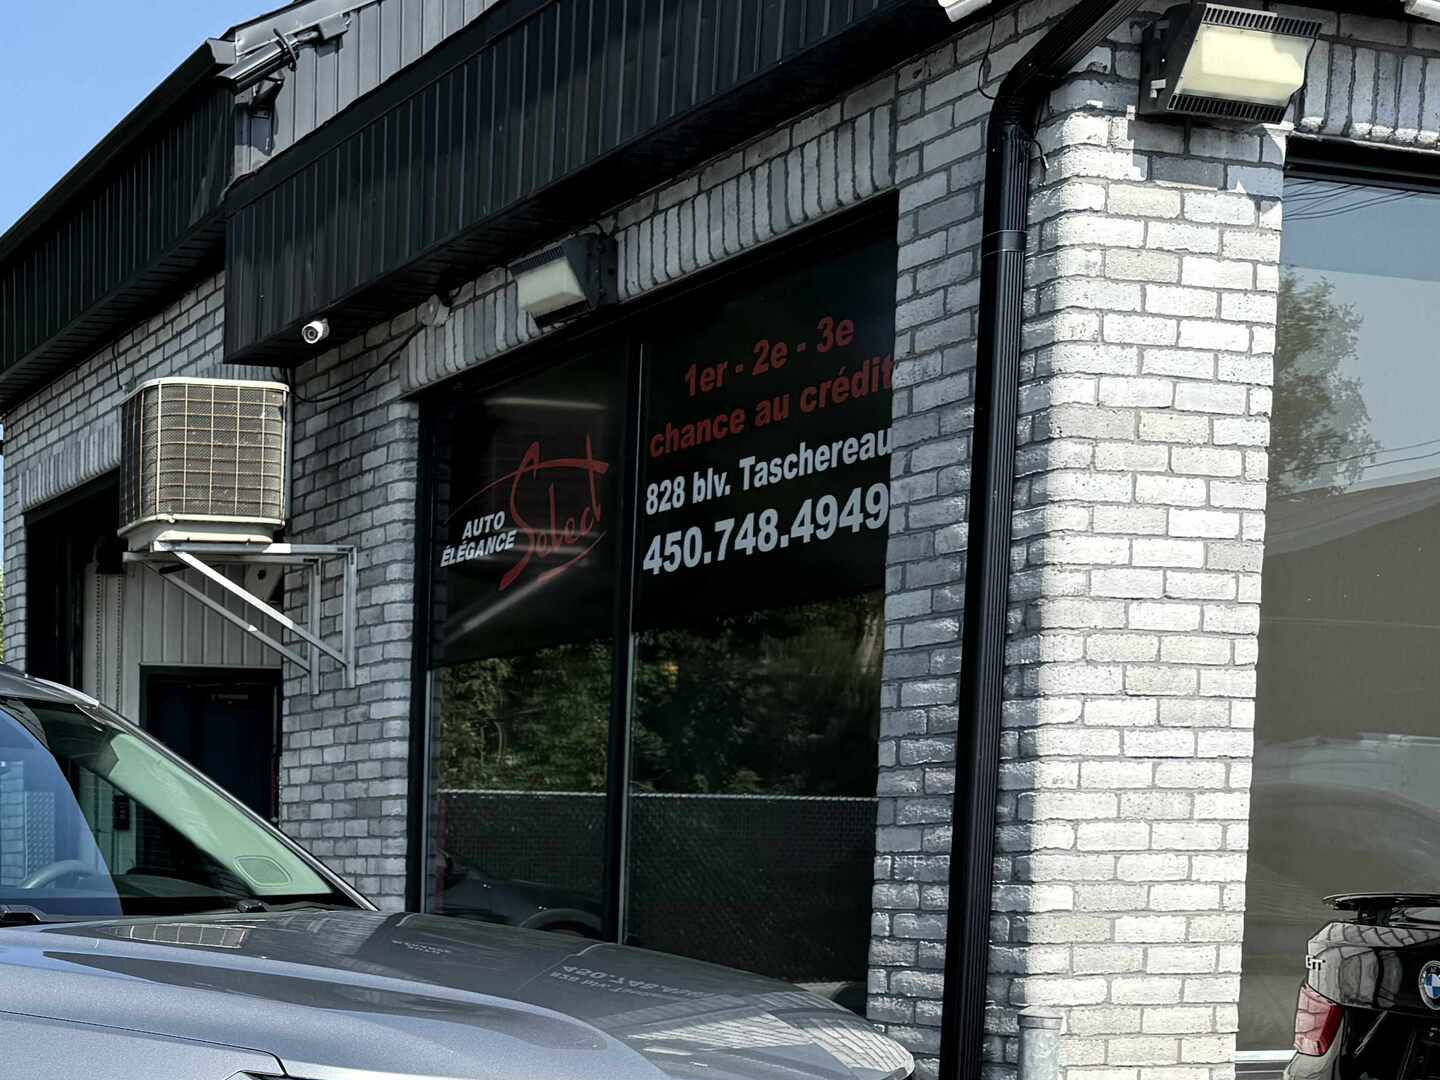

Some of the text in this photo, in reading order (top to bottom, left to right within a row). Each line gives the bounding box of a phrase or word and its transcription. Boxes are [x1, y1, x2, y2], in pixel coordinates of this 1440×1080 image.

[685, 361, 728, 396] 1er
[752, 339, 788, 376] 2e
[816, 316, 854, 353] 3e
[650, 352, 894, 458] chance au crédit
[646, 427, 892, 515] 828 blv. Taschereau
[440, 530, 517, 568] ÉLÉGANCE
[462, 511, 506, 540] AUTO
[643, 482, 889, 575] 450.748.4949
